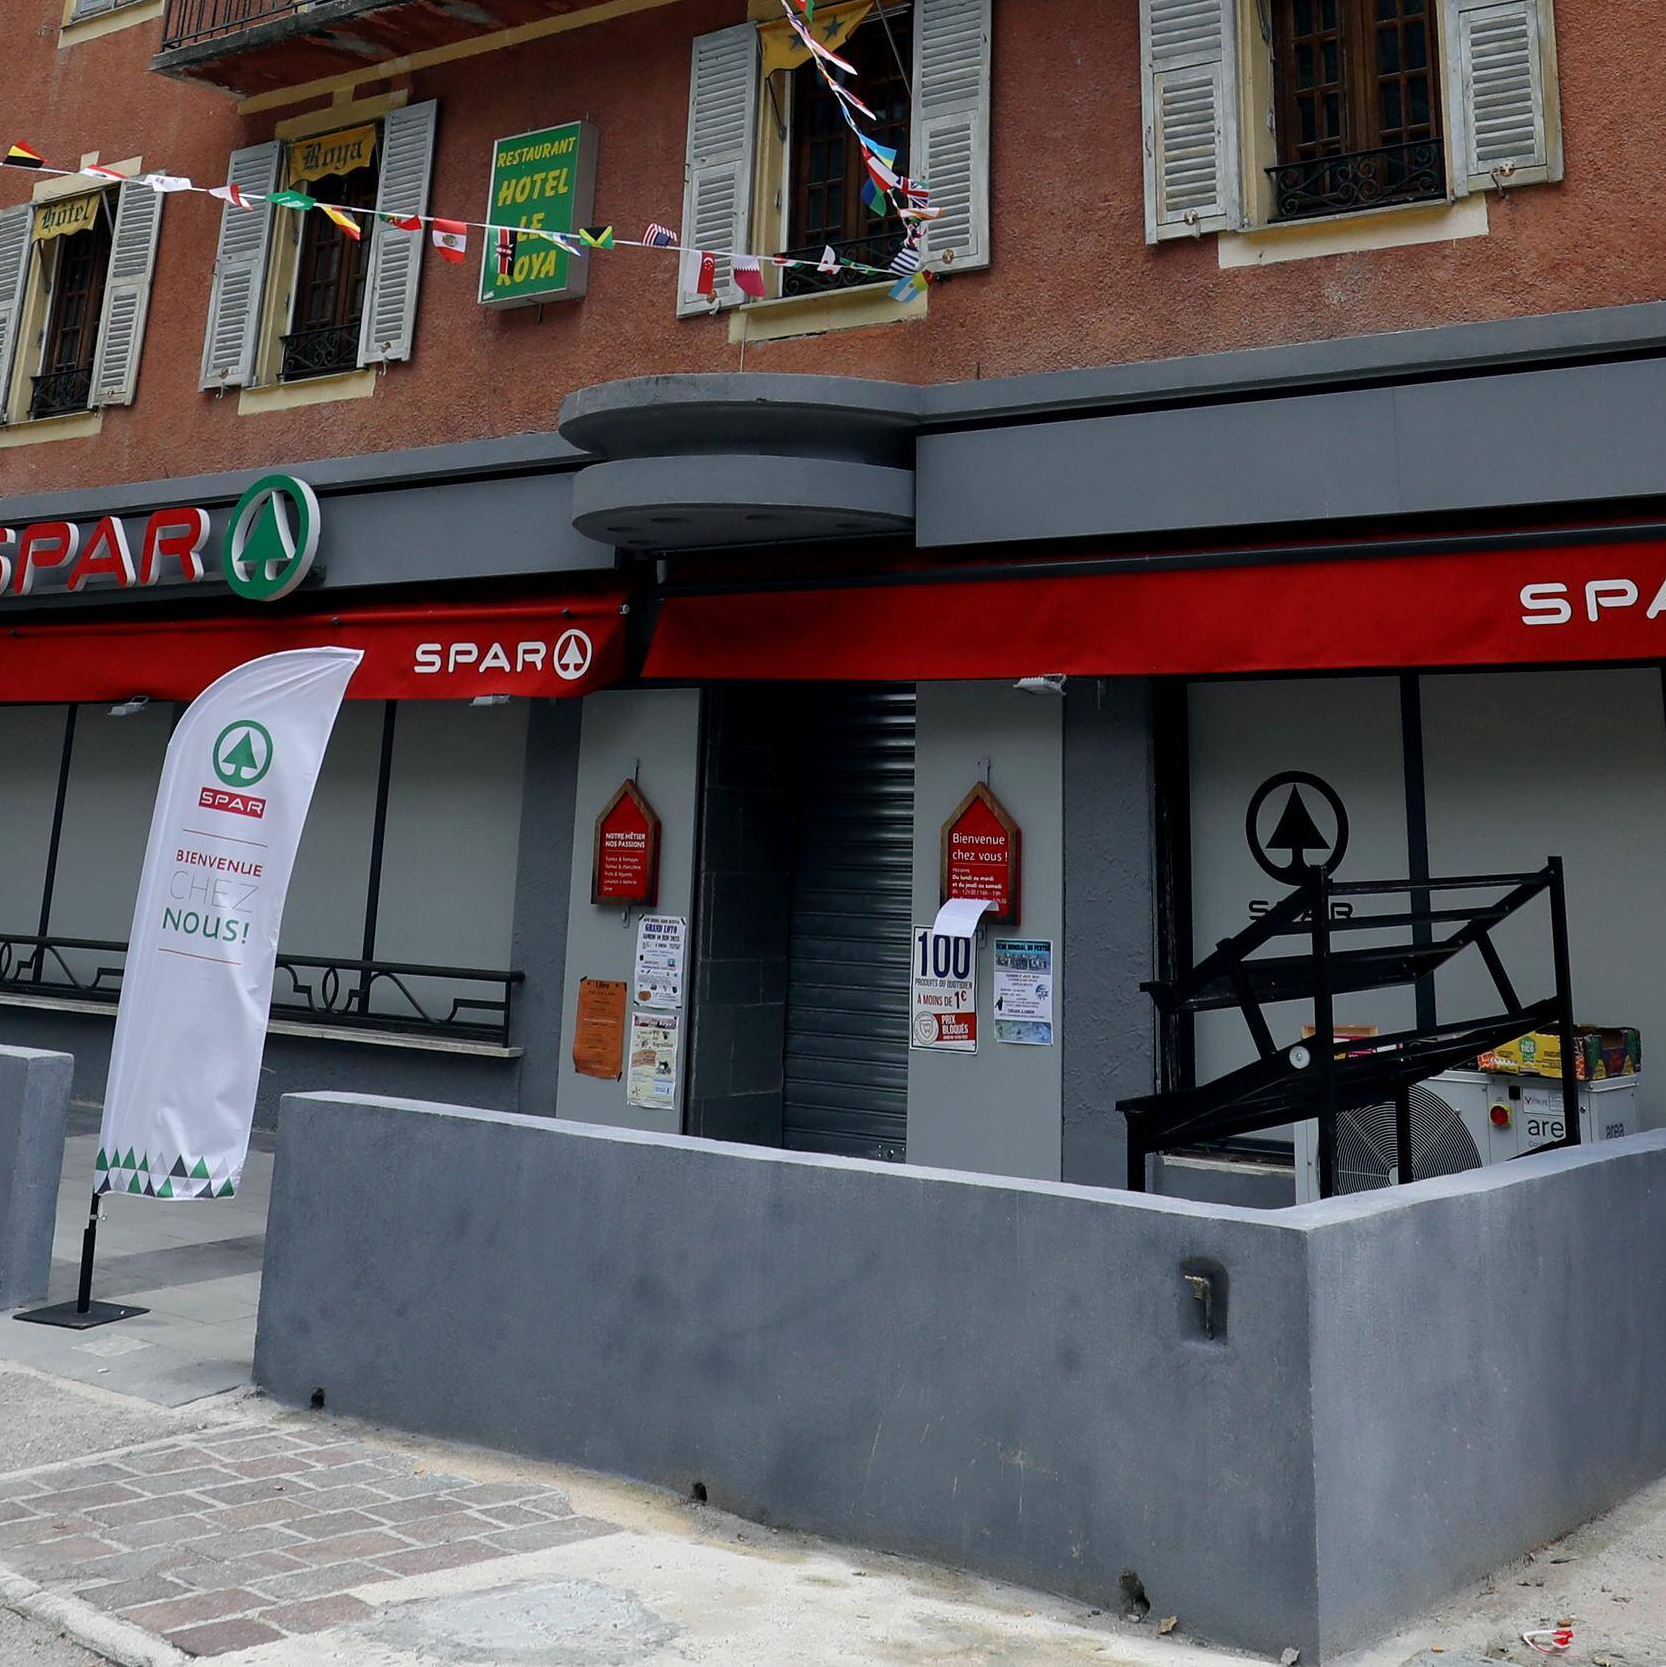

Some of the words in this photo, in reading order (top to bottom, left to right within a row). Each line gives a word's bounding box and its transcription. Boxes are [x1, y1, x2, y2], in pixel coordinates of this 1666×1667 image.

[302, 136, 364, 173] Roya
[496, 136, 576, 168] RESTAURANT
[497, 167, 569, 207] HOTEL
[40, 196, 93, 231] Hôtel
[517, 212, 545, 242] LE
[414, 641, 547, 674] SPAR
[200, 791, 263, 814] SPAR
[605, 832, 624, 840] NOTRE
[952, 832, 1005, 845] Bienvenue
[176, 849, 263, 877] BIENVENUE
[952, 849, 975, 860] chez
[979, 852, 1002, 861] vous
[169, 870, 259, 913] CHEZ
[162, 907, 250, 944] NOUS!
[1249, 900, 1353, 924] SR
[918, 931, 971, 980] 100
[915, 977, 938, 987] PRODUITS
[939, 980, 946, 988] DU
[947, 980, 972, 990] QUOTIDIEN
[922, 994, 942, 1006] MOINS
[944, 996, 952, 1006] DE
[941, 1015, 956, 1024] PRIX
[1527, 1119, 1566, 1138] are
